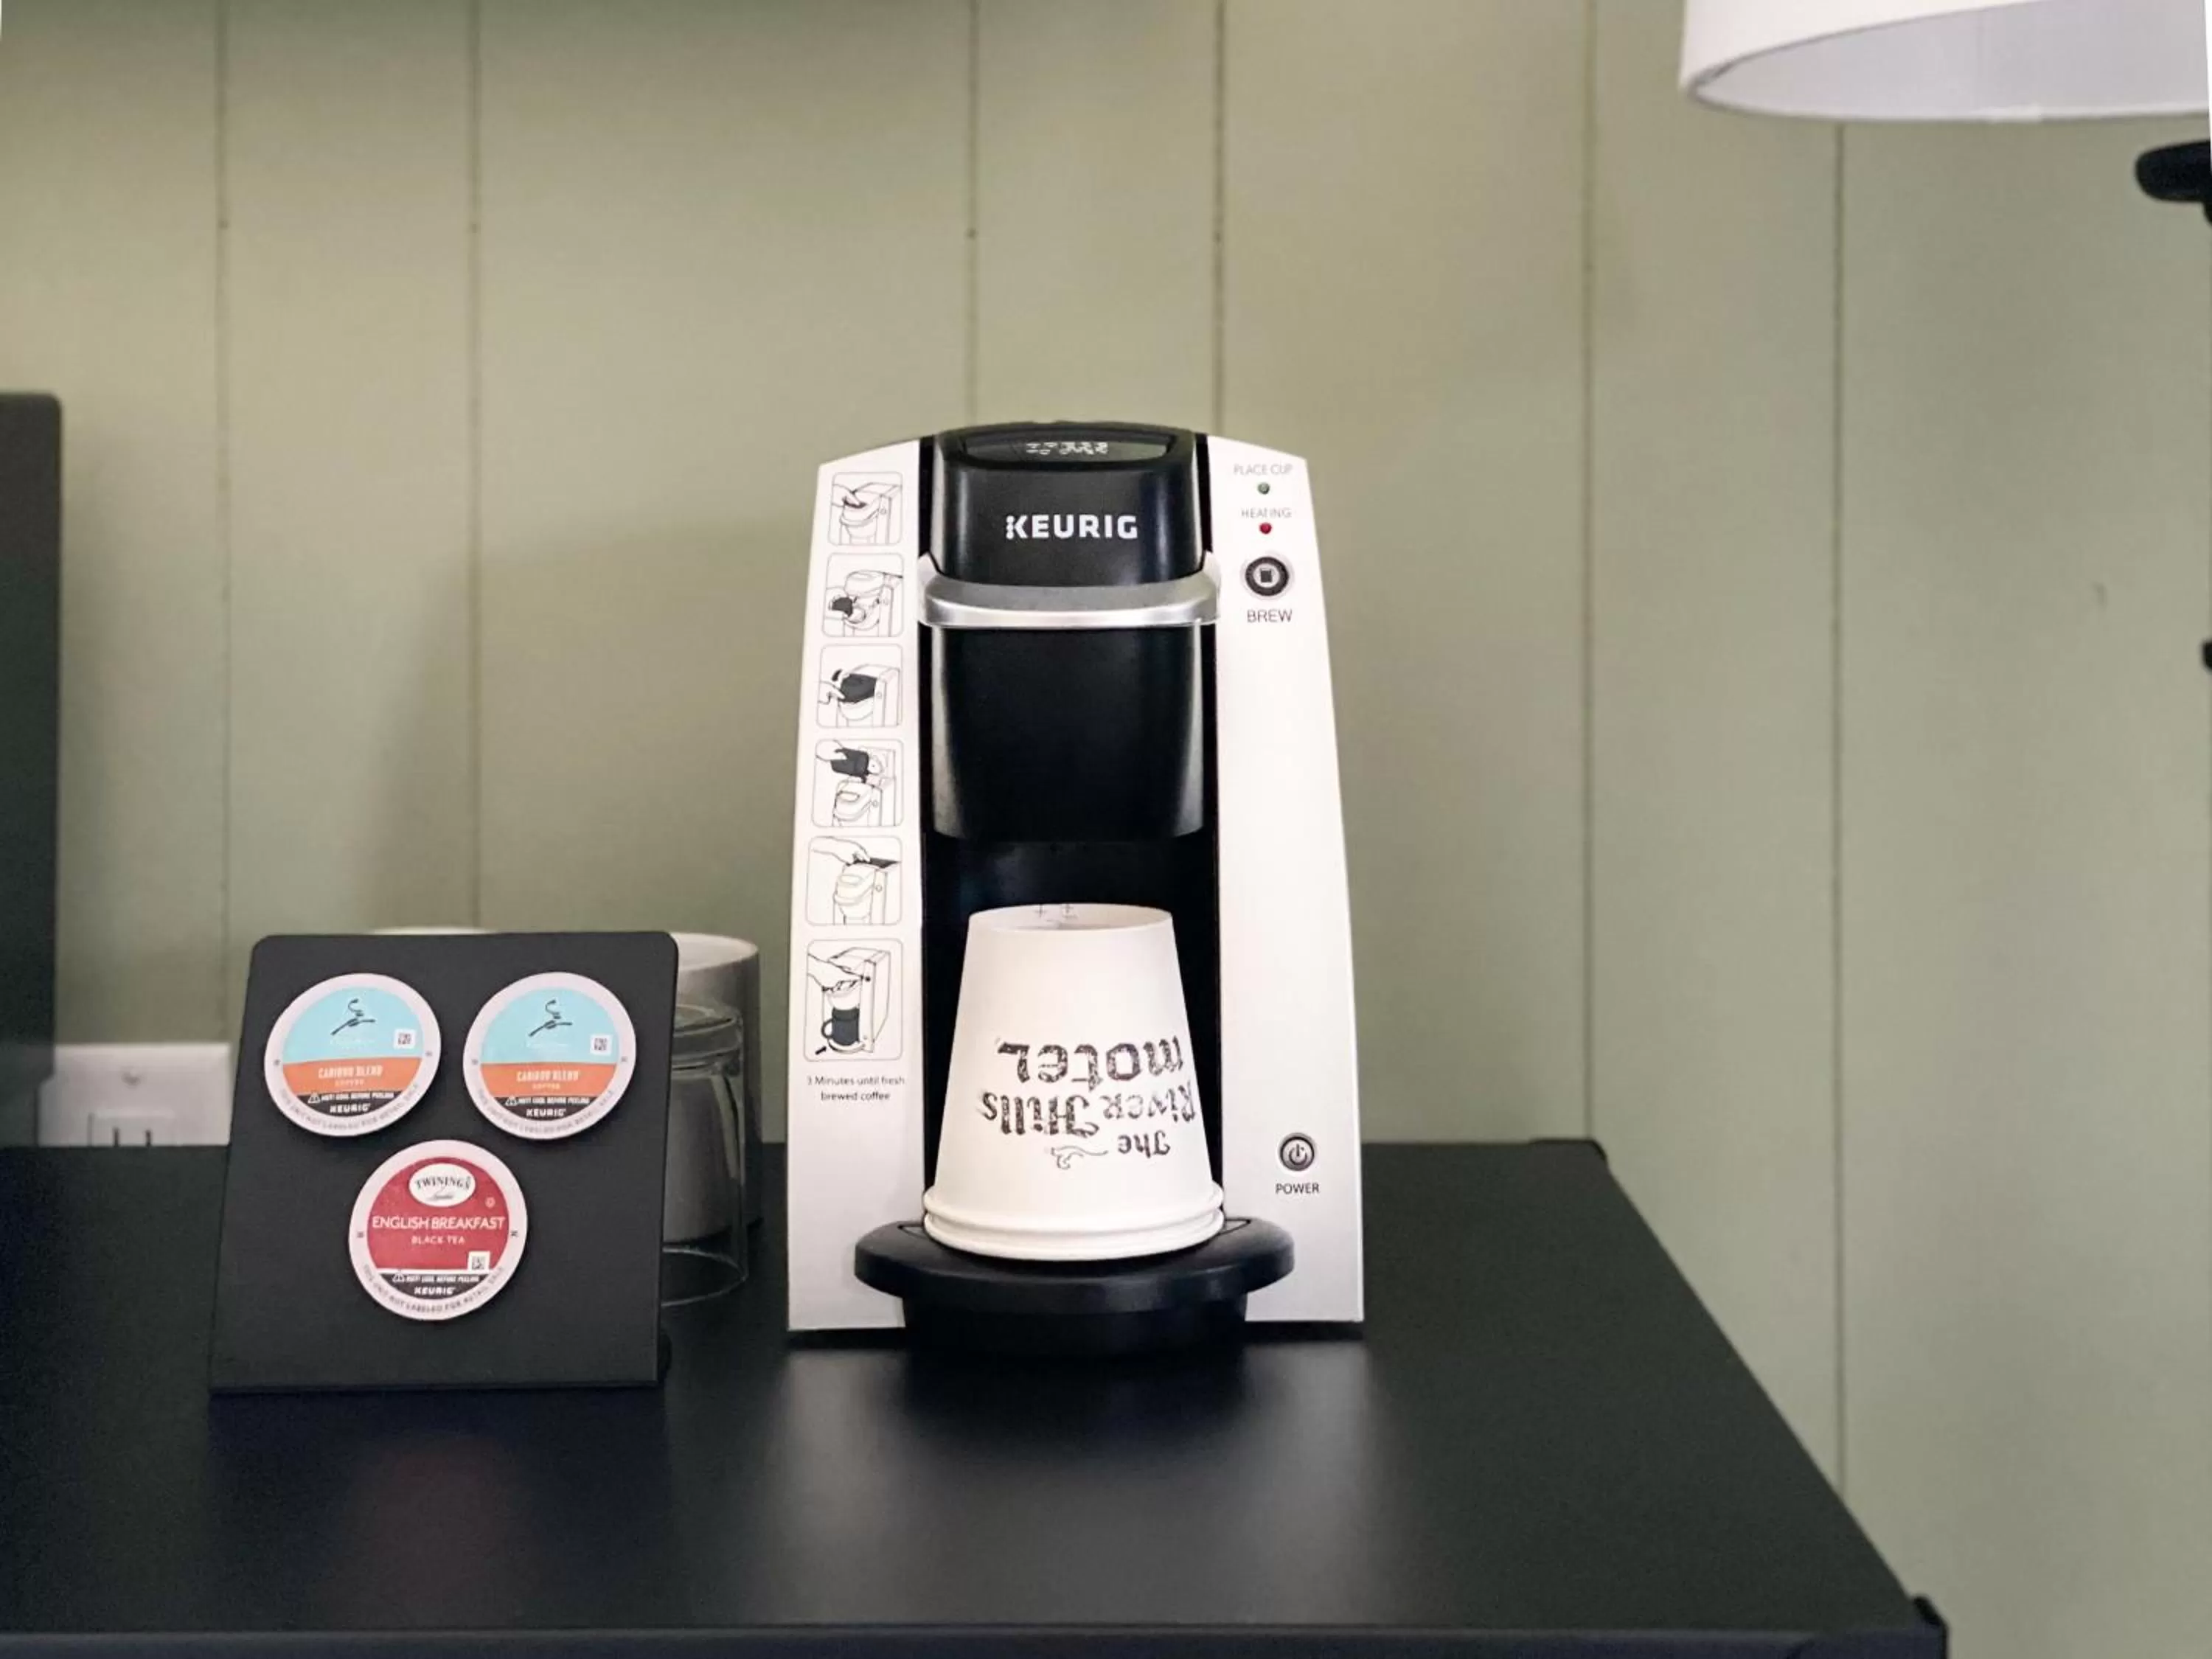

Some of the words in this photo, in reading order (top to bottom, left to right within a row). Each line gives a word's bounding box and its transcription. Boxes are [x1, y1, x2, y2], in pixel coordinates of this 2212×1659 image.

[1234, 463, 1267, 475] PLACE
[1270, 463, 1293, 475] CUP
[1005, 514, 1138, 539] KEURIG
[1246, 609, 1293, 623] BREW
[814, 1076, 855, 1085] Minutes
[858, 1076, 880, 1085] until
[881, 1076, 905, 1085] fresh
[821, 1091, 858, 1101] brewed
[860, 1091, 891, 1102] coffee
[330, 1102, 371, 1113] KEURIG
[526, 1108, 566, 1117] KEURIG
[979, 1091, 1099, 1138] Hills
[1118, 1130, 1171, 1158] The
[1275, 1182, 1320, 1194] POWER
[372, 1215, 429, 1229] ENGLISH
[431, 1215, 506, 1229] BREAKFAST
[411, 1236, 443, 1245] BLACK
[447, 1236, 465, 1245] TEA
[414, 1286, 456, 1295] KEURIG
